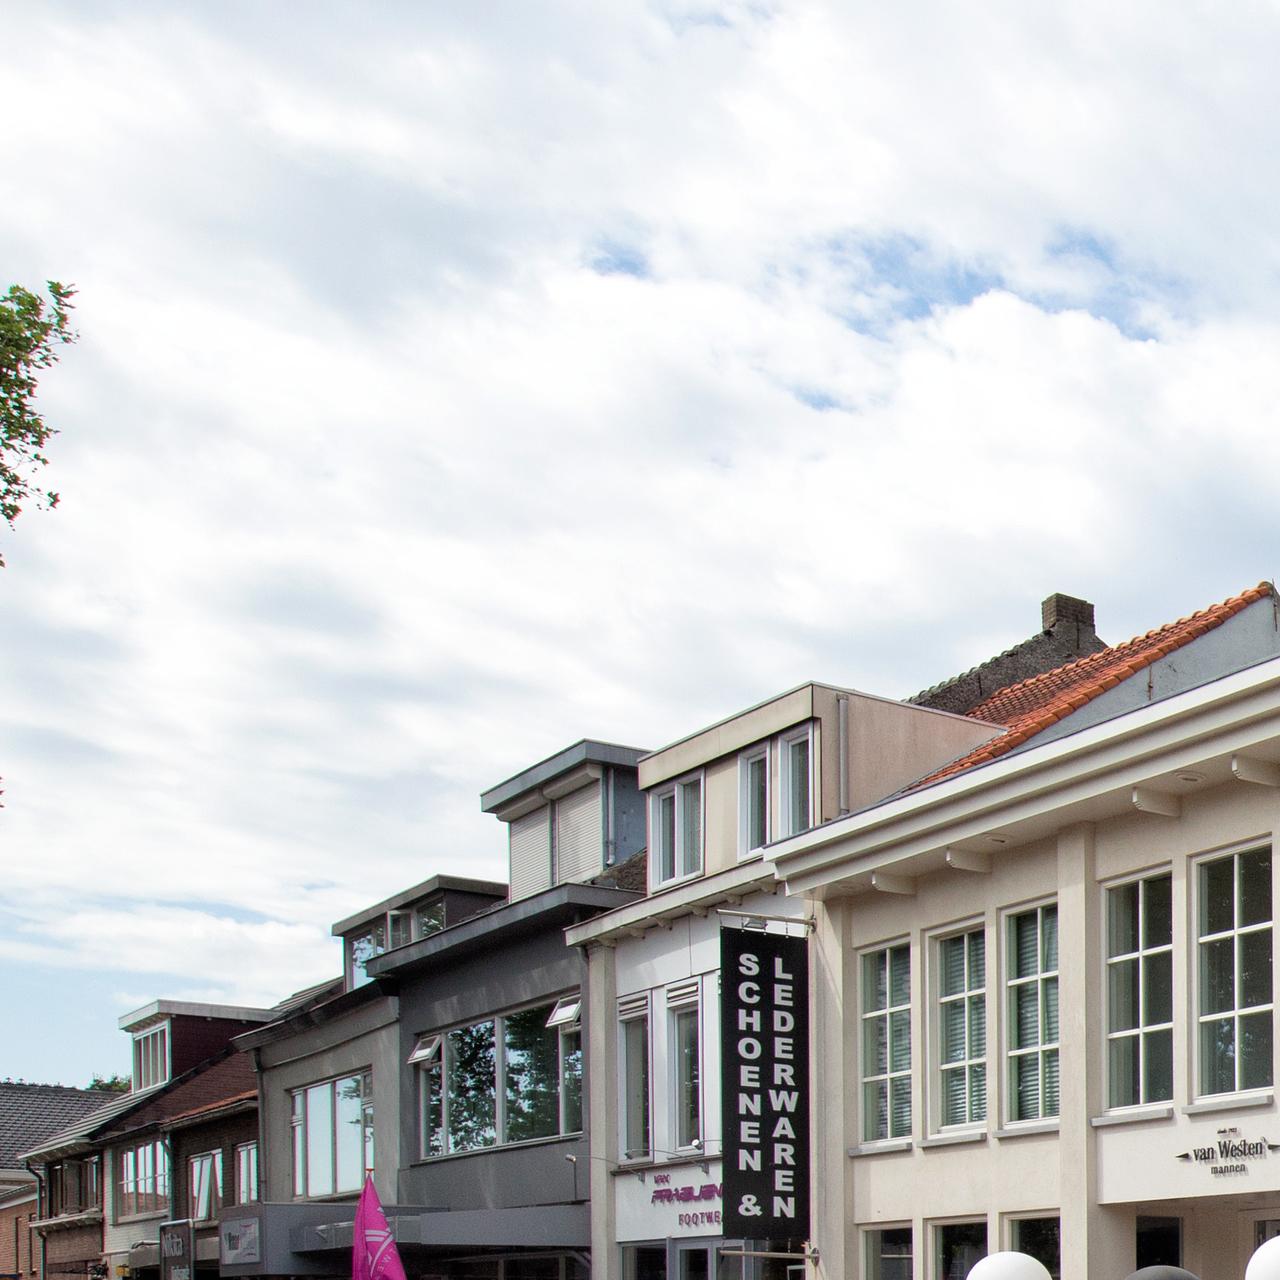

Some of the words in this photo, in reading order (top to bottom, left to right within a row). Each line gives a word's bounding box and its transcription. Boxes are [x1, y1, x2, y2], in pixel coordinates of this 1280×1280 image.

[738, 953, 762, 1171] SCHOENEN
[768, 957, 799, 1218] LEDERWAREN
[1193, 1146, 1215, 1160] van
[1211, 1163, 1246, 1174] mannen
[738, 1194, 763, 1217] &
[678, 1211, 722, 1226] FOOTWE
